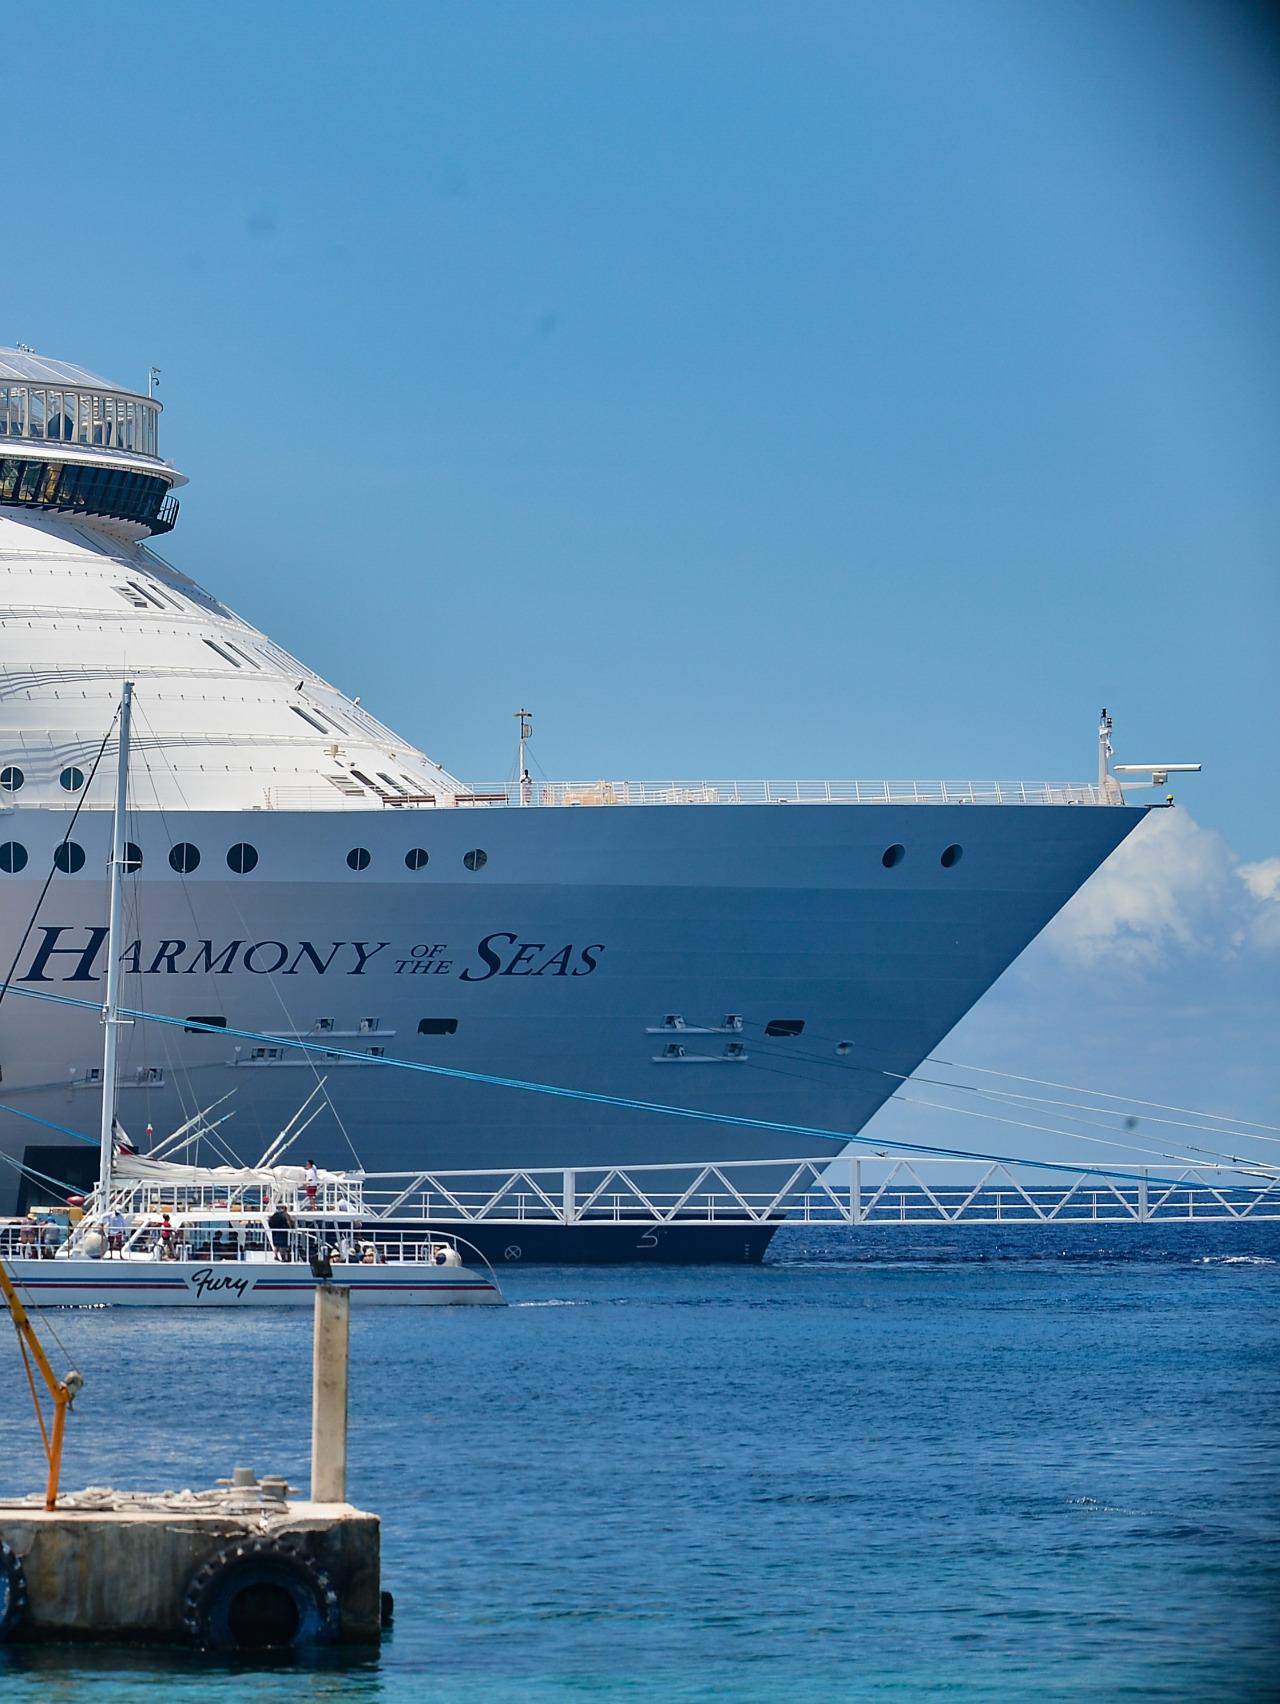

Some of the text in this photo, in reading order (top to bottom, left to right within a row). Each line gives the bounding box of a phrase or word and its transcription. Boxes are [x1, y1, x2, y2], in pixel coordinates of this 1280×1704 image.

[15, 925, 605, 982] HARMONY OF THE SEAS
[191, 1267, 249, 1299] Fury
